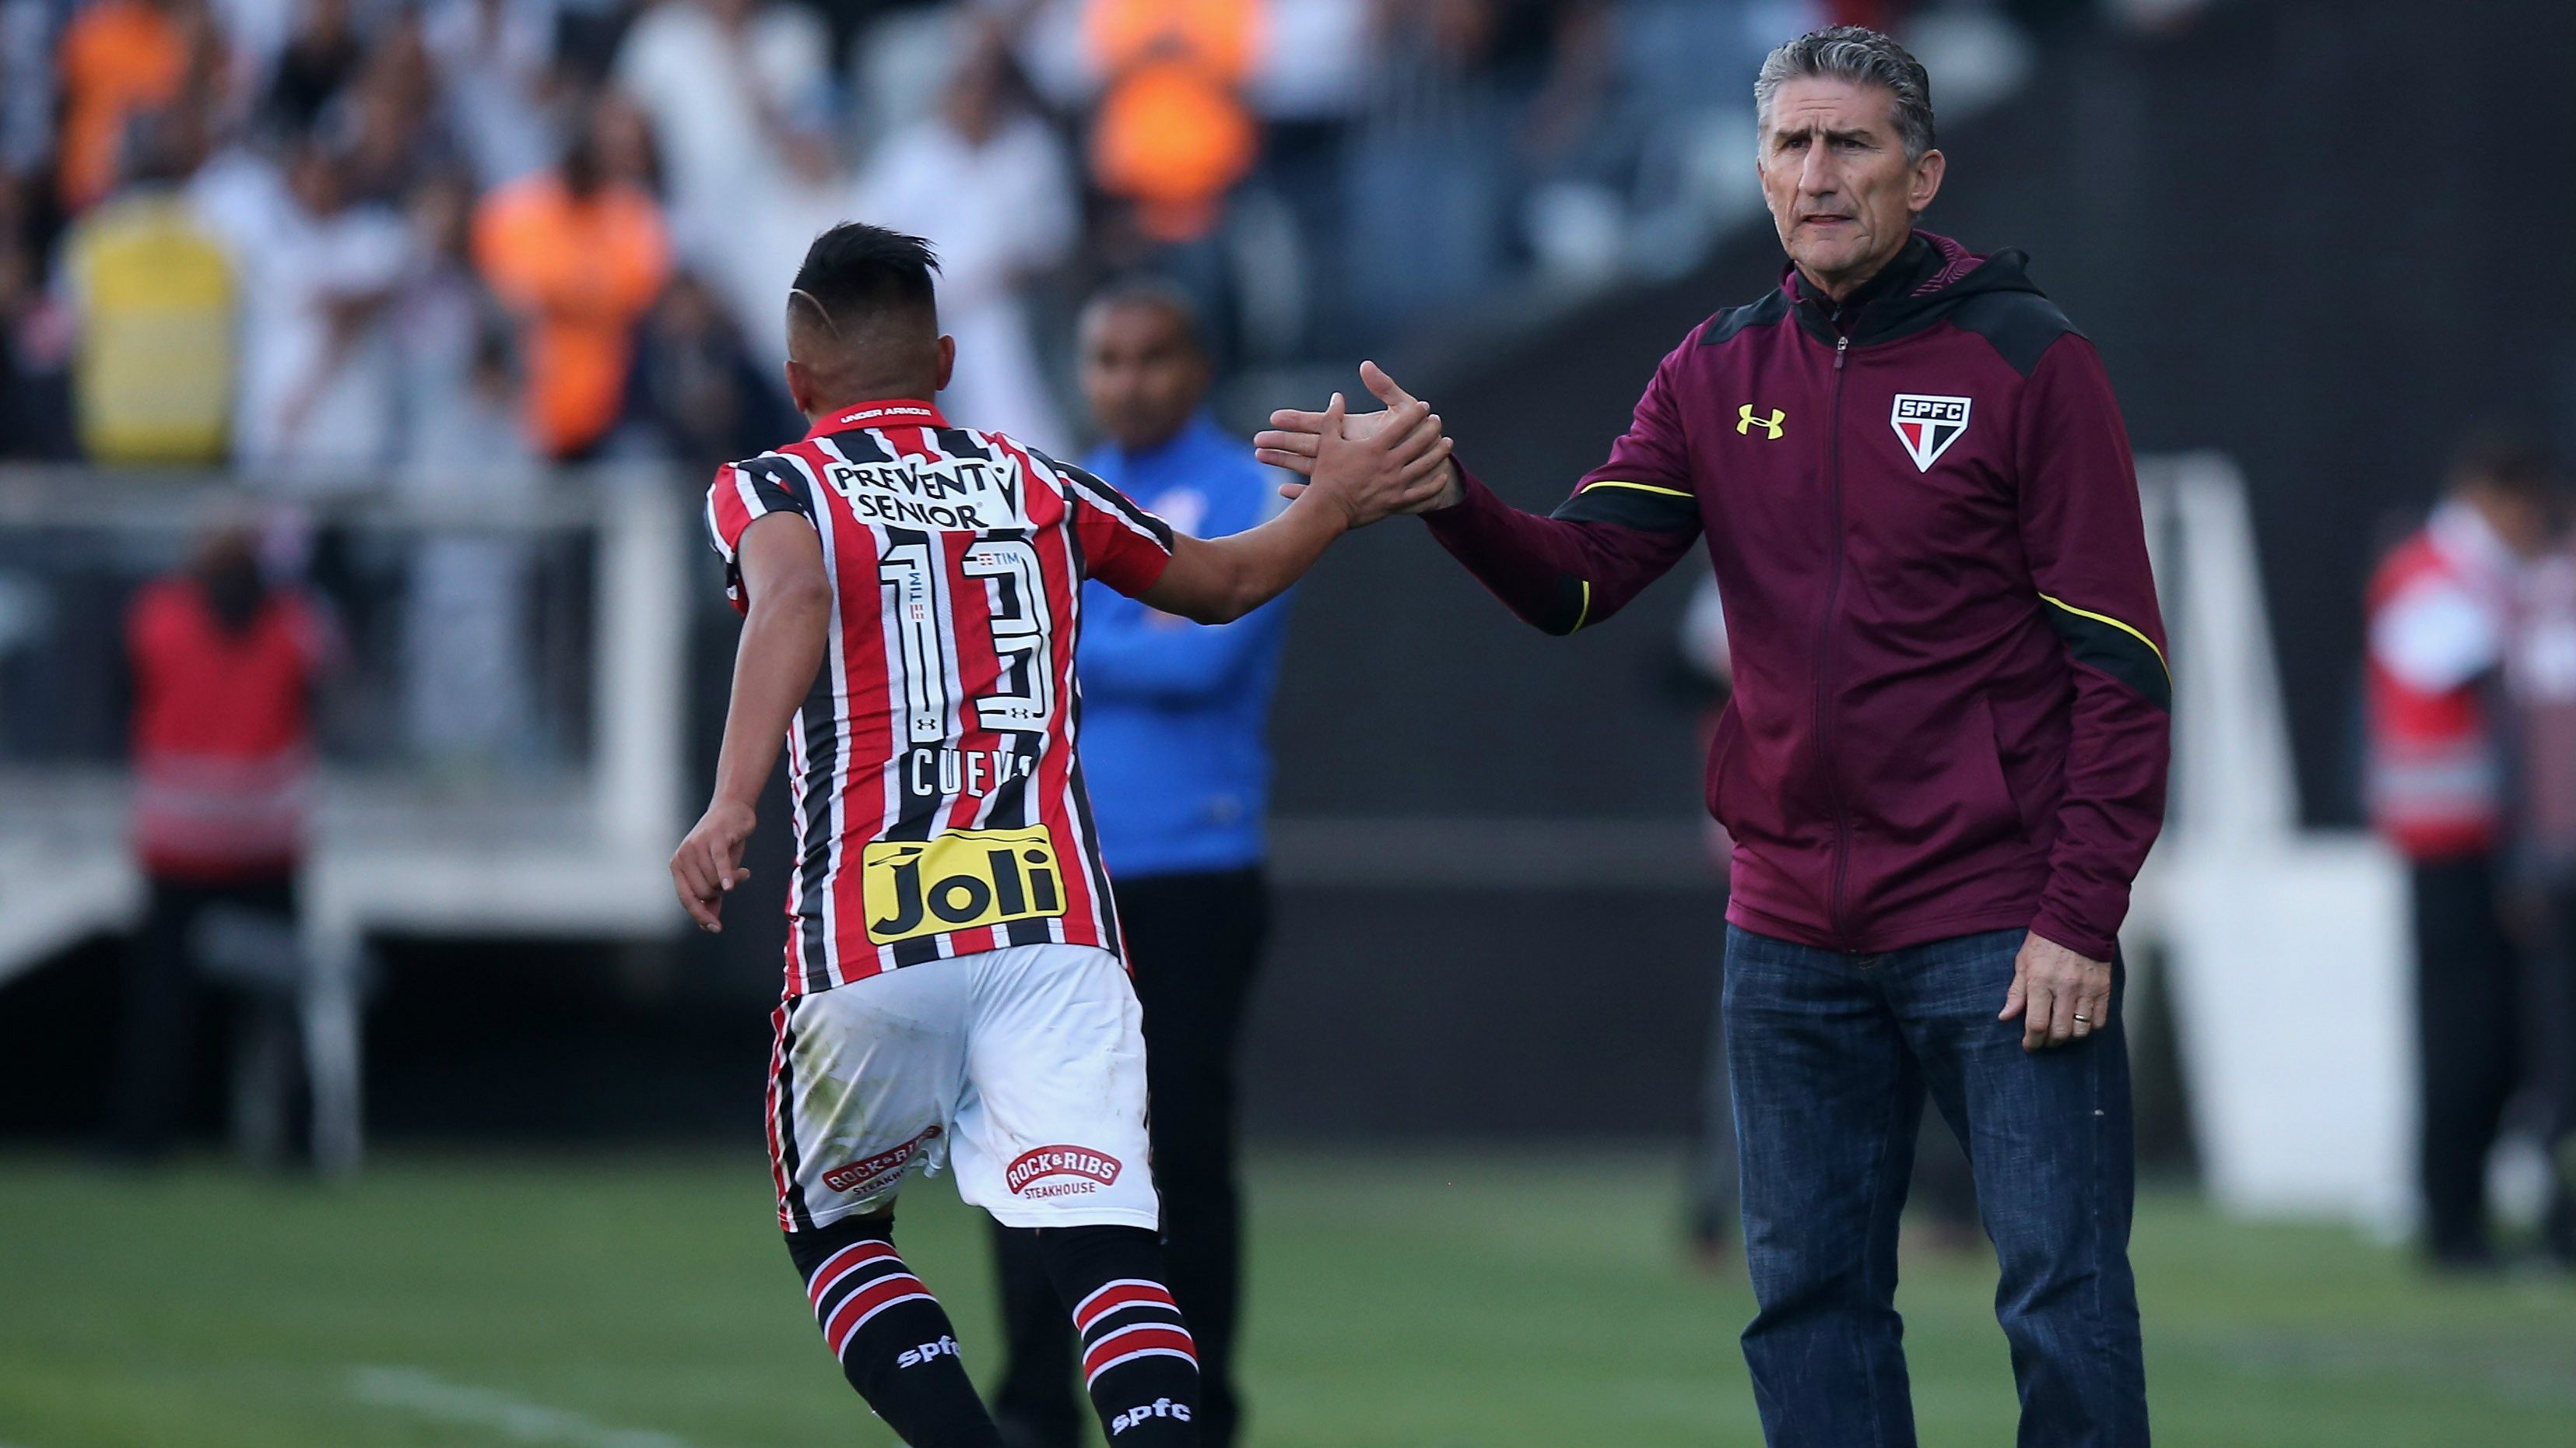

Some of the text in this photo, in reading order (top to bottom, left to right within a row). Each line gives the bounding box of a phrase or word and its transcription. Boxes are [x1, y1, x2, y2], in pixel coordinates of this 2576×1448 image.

[841, 407, 932, 424] UNDER ARMOUR
[1900, 401, 1962, 420] SPFC
[833, 463, 987, 500] PREVENT
[858, 494, 989, 529] SENIOR
[994, 552, 1021, 565] TIM
[909, 571, 922, 602] TIM
[879, 539, 1055, 743] 13
[870, 846, 1059, 935] Joli
[1009, 1151, 1116, 1188] ROCK&RIBS
[1024, 1183, 1096, 1200] STEAKHOUSE
[1111, 1397, 1191, 1436] spfc
